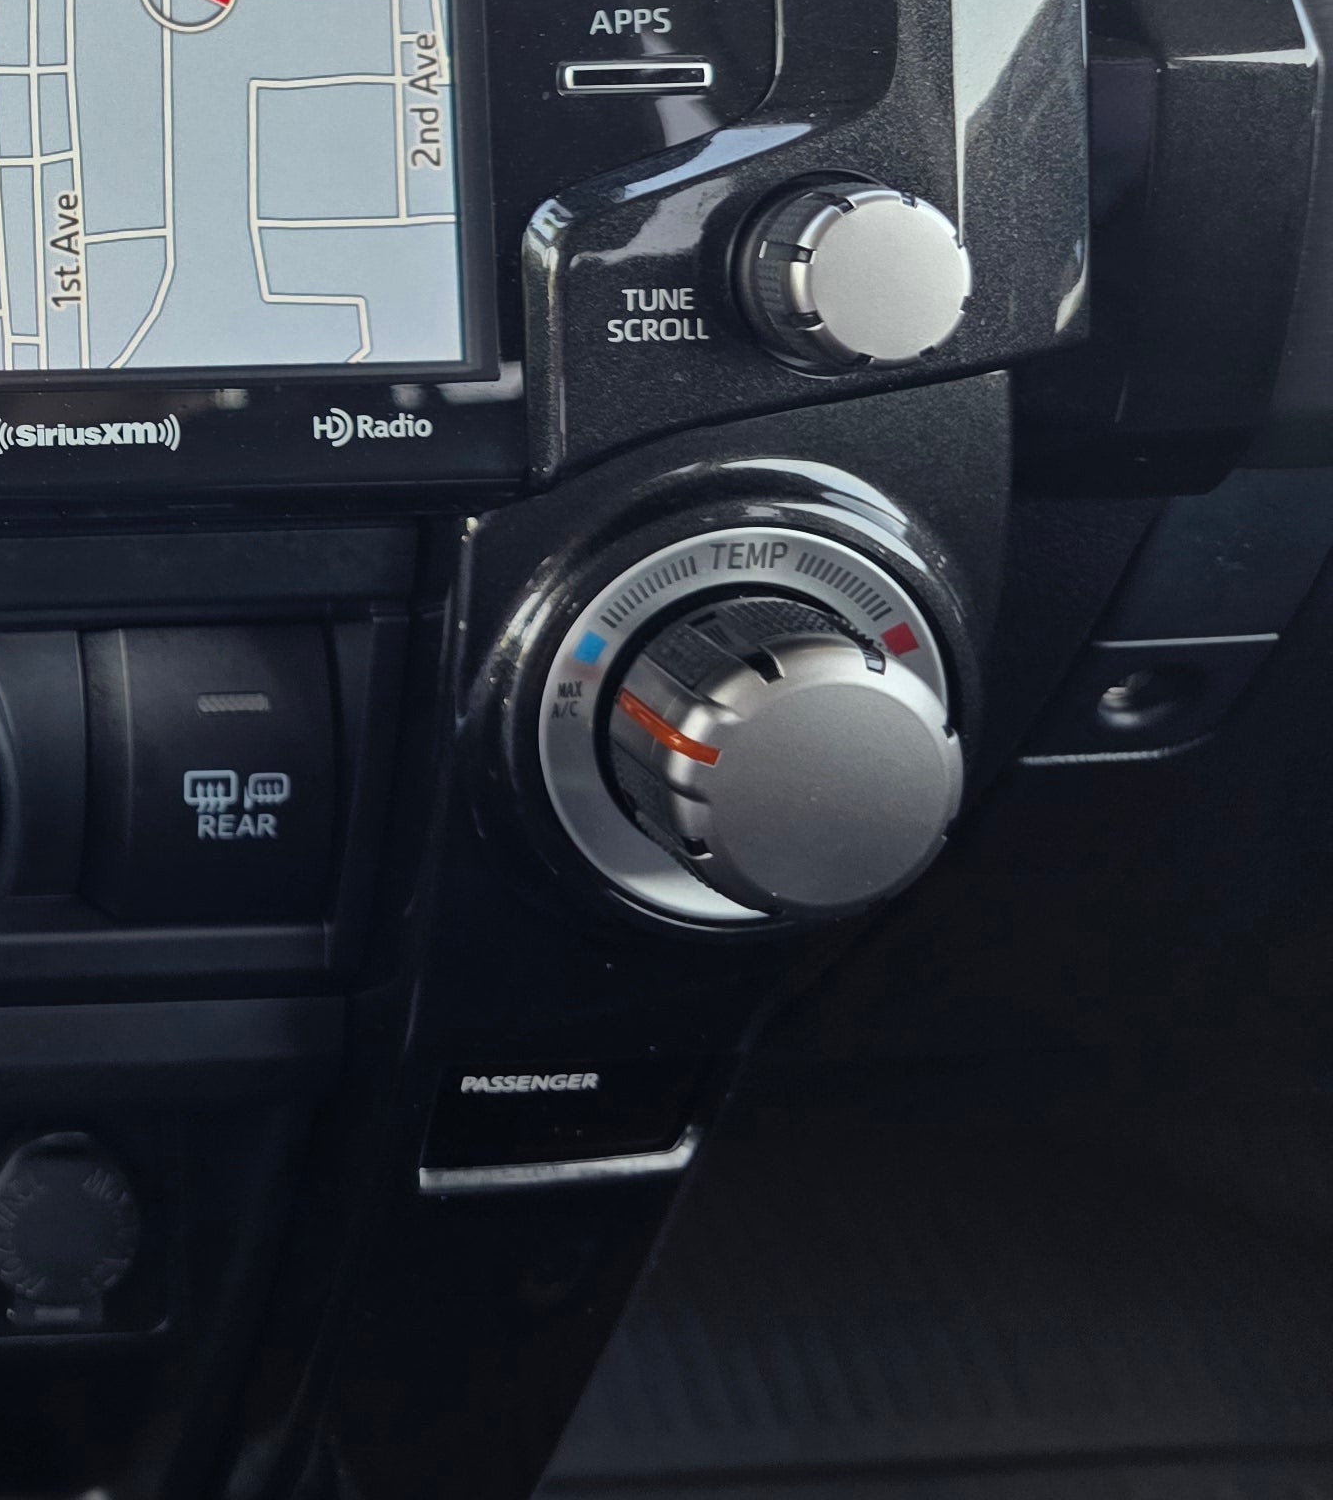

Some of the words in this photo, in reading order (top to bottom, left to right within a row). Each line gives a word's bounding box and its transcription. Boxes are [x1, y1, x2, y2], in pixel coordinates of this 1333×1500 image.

[590, 8, 671, 35] APPS
[409, 33, 438, 96] Ave
[409, 107, 441, 167] 2nd
[50, 193, 80, 256] Ave
[51, 265, 81, 308] 1st
[622, 288, 694, 311] TUNE
[608, 318, 709, 342] SCROLL
[313, 408, 354, 447] HD
[357, 413, 432, 438] Radio
[709, 541, 788, 571] TEMP
[558, 680, 583, 699] MAX
[551, 700, 579, 719] A/C
[197, 814, 276, 840] REAR
[461, 1073, 598, 1092] PASSENGER
